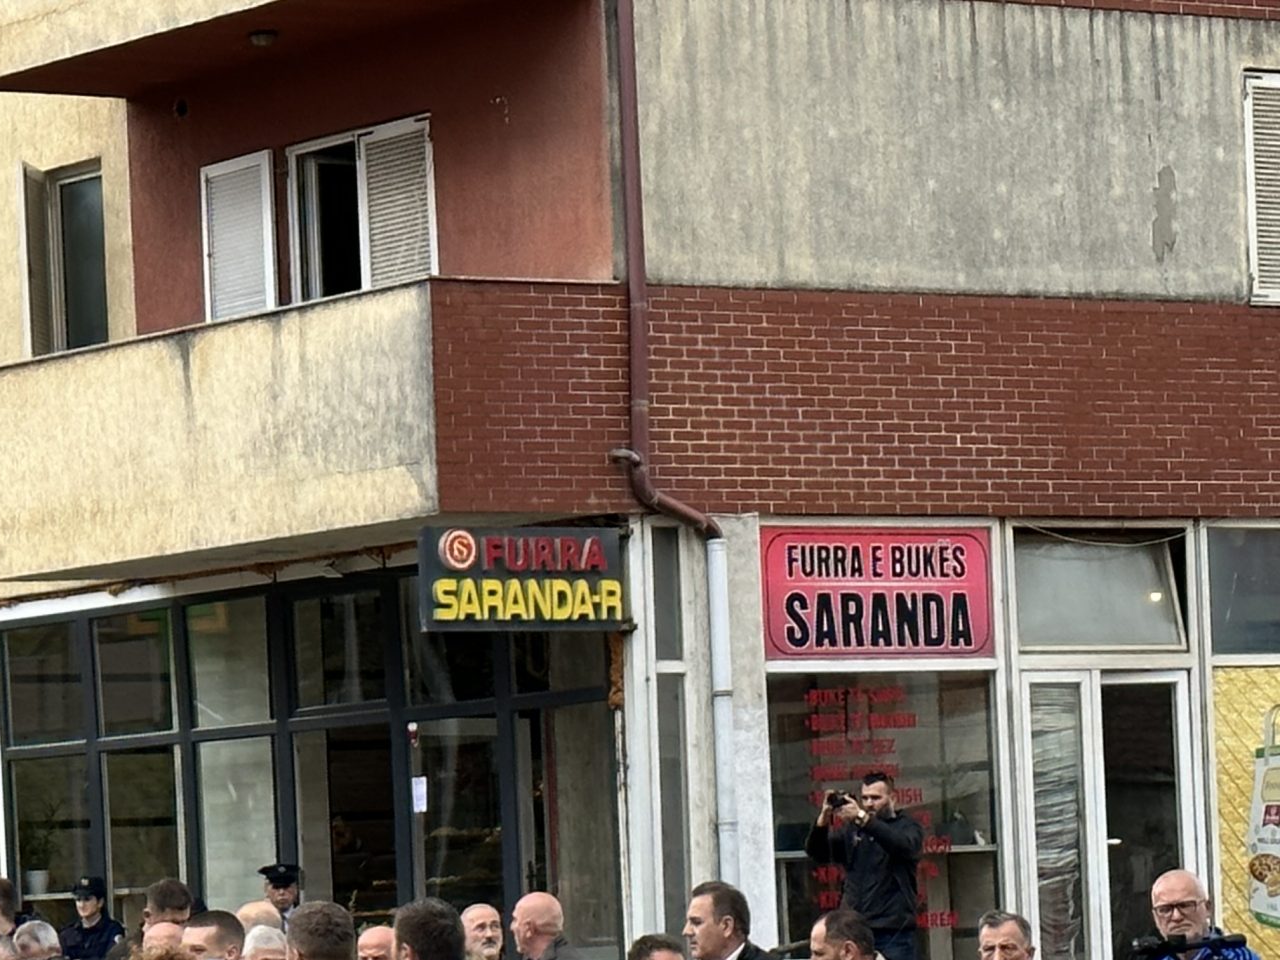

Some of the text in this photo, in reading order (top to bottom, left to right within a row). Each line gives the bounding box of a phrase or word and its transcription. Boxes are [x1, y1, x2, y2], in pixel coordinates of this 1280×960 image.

[483, 535, 608, 572] FURRA
[786, 539, 967, 579] FURRA E BUKËS
[432, 578, 622, 621] SARANDA-R
[785, 590, 974, 648] SARANDA
